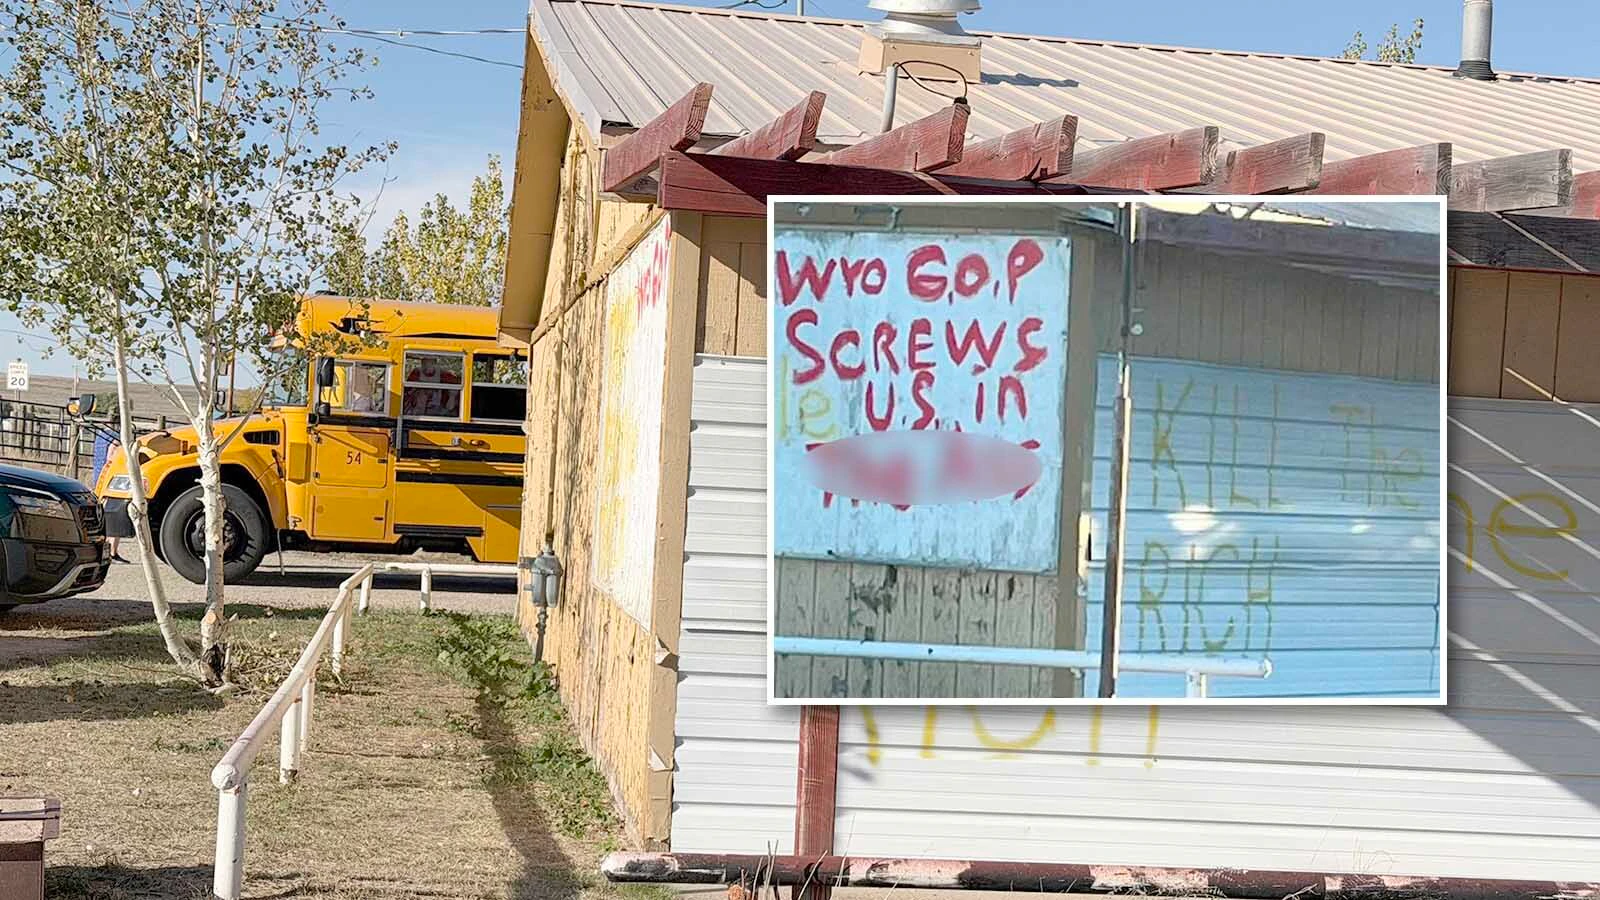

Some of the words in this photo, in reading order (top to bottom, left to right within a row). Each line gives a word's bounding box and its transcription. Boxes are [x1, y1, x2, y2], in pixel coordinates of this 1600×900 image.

[11, 376, 26, 386] 20
[786, 308, 1048, 385] SCREWS
[346, 451, 361, 465] 54
[1150, 376, 1284, 508] KILL
[1136, 536, 1279, 657] RICH
